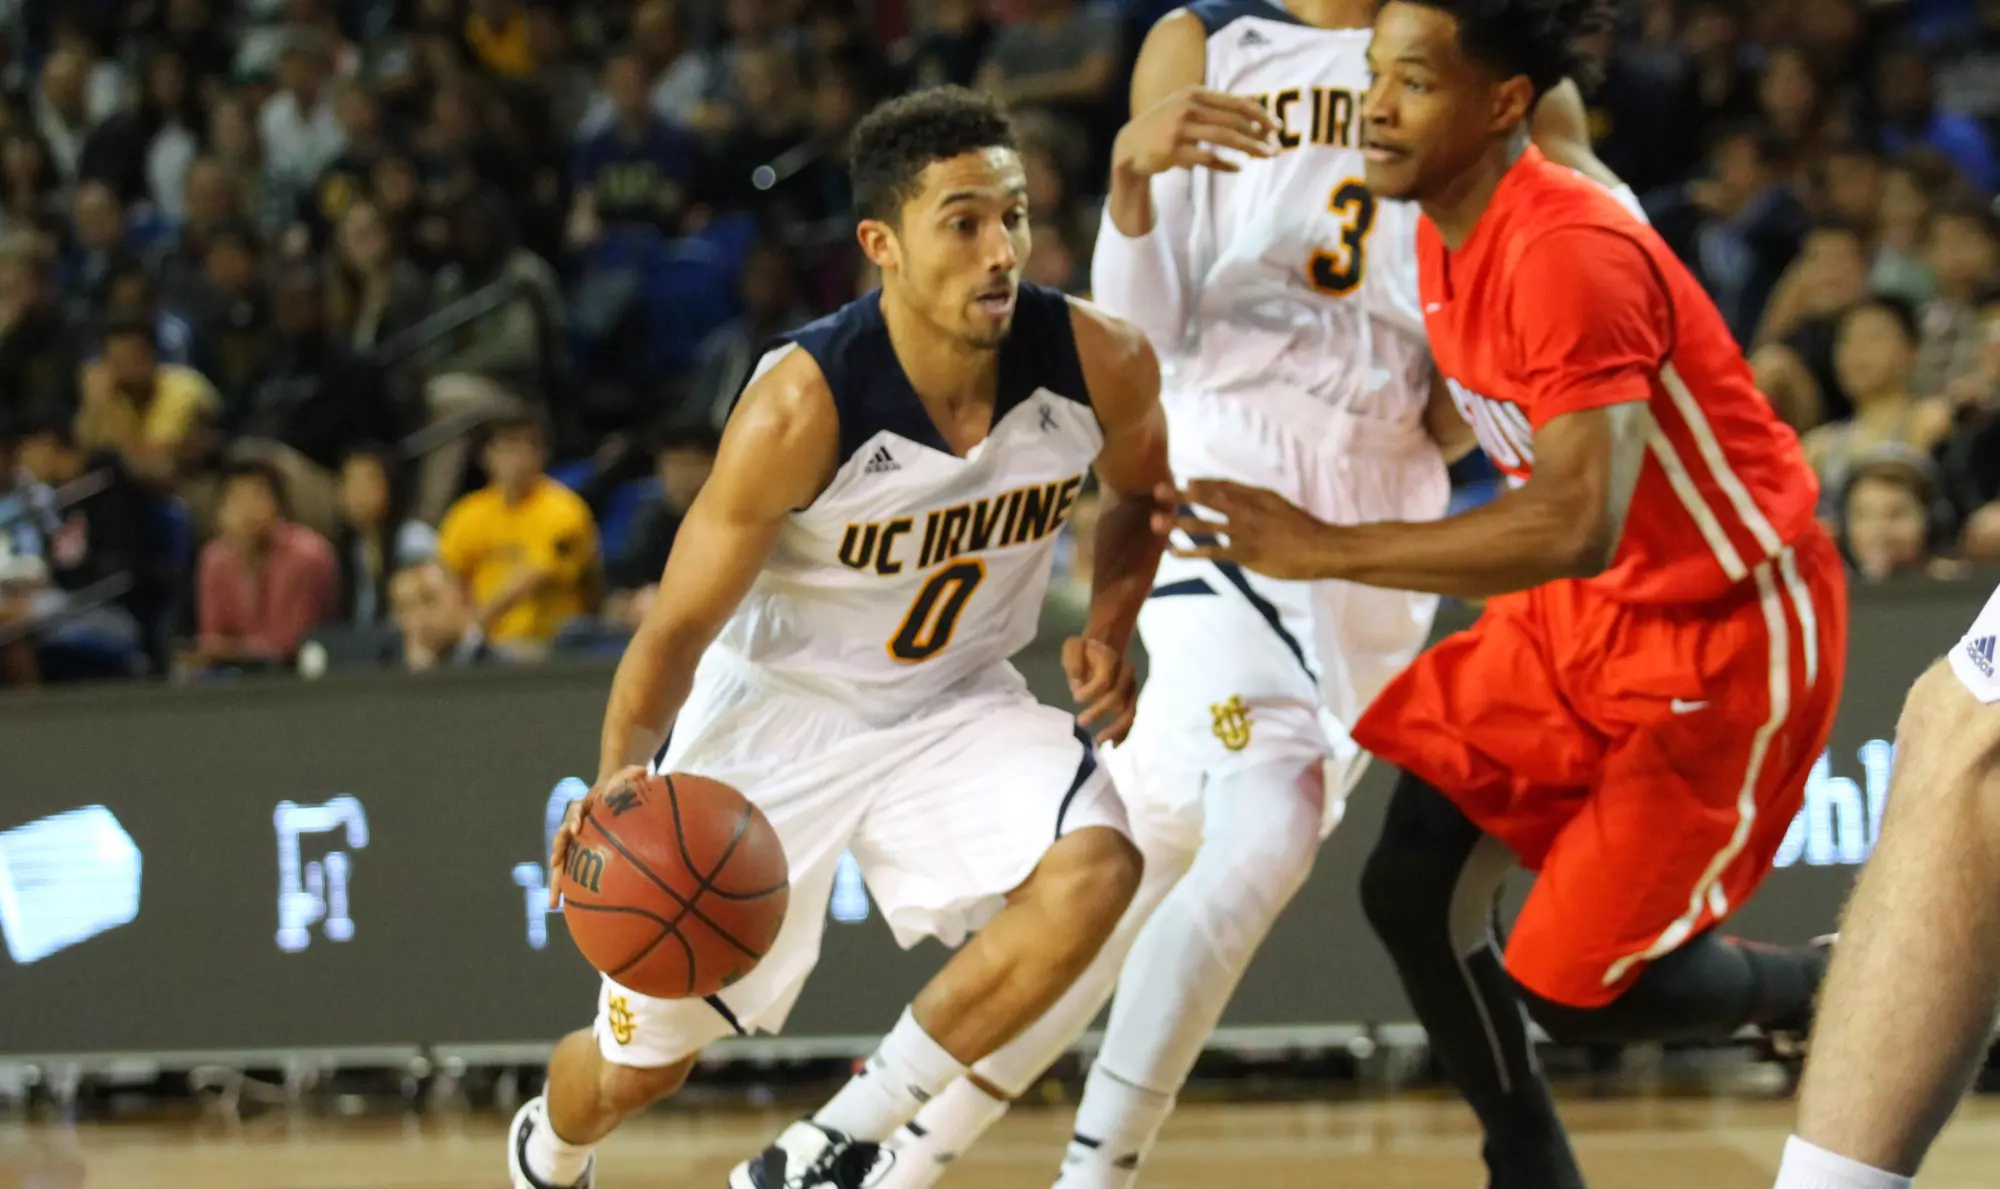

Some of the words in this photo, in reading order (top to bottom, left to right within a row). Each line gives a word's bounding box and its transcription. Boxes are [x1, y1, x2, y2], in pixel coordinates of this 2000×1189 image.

[1259, 86, 1302, 149] C
[1305, 176, 1378, 298] 3
[838, 516, 915, 576] UC
[916, 473, 1083, 569] IRVINE
[885, 556, 987, 665] 0
